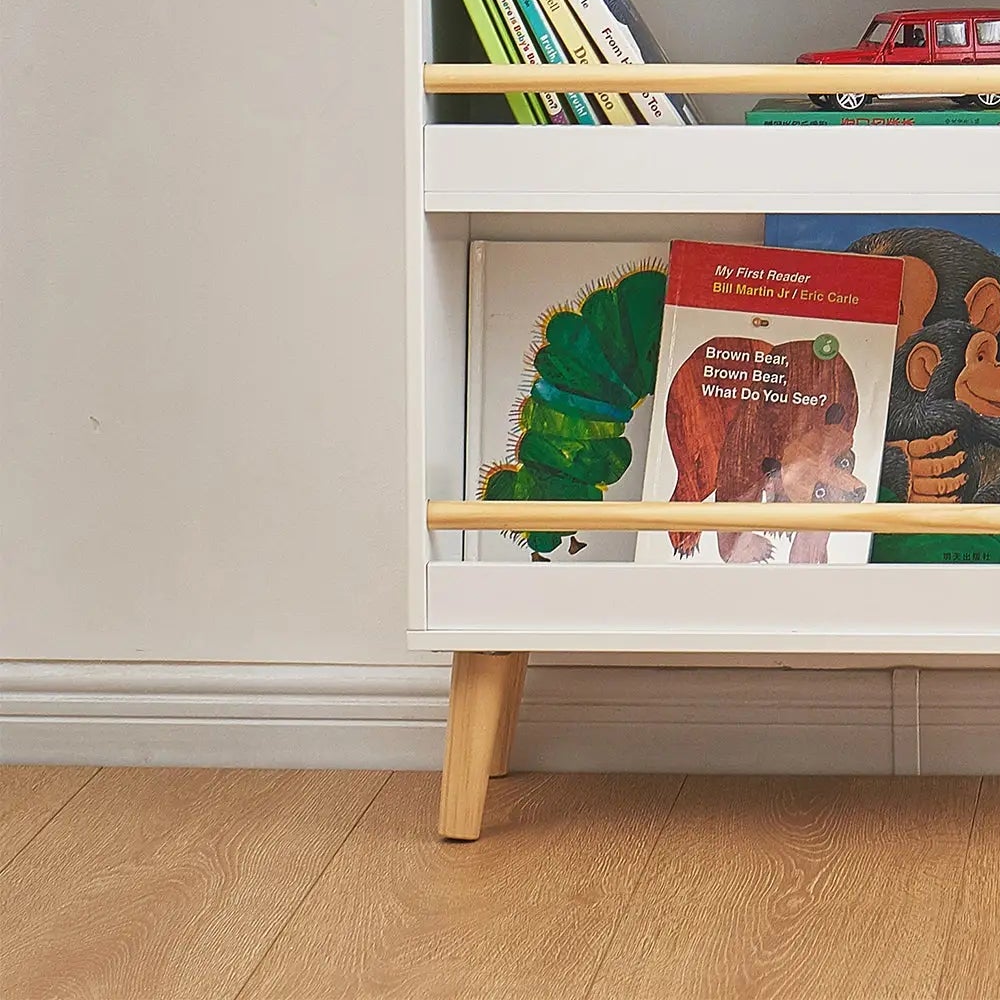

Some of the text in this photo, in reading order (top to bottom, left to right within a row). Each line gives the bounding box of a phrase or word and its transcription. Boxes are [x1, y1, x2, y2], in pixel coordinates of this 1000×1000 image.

[510, 16, 518, 25] is
[513, 25, 530, 52] Baby's
[573, 46, 589, 64] De
[540, 33, 588, 117] Brush, rush!
[601, 27, 623, 57] From
[647, 96, 662, 118] Toe
[714, 265, 811, 284] My First Reader
[712, 282, 859, 305] Bill Martin Jr / Eric Carle
[705, 346, 789, 367] Brown Bear,
[703, 365, 787, 386] Brown Bear,
[701, 383, 828, 407] What Do You See?
